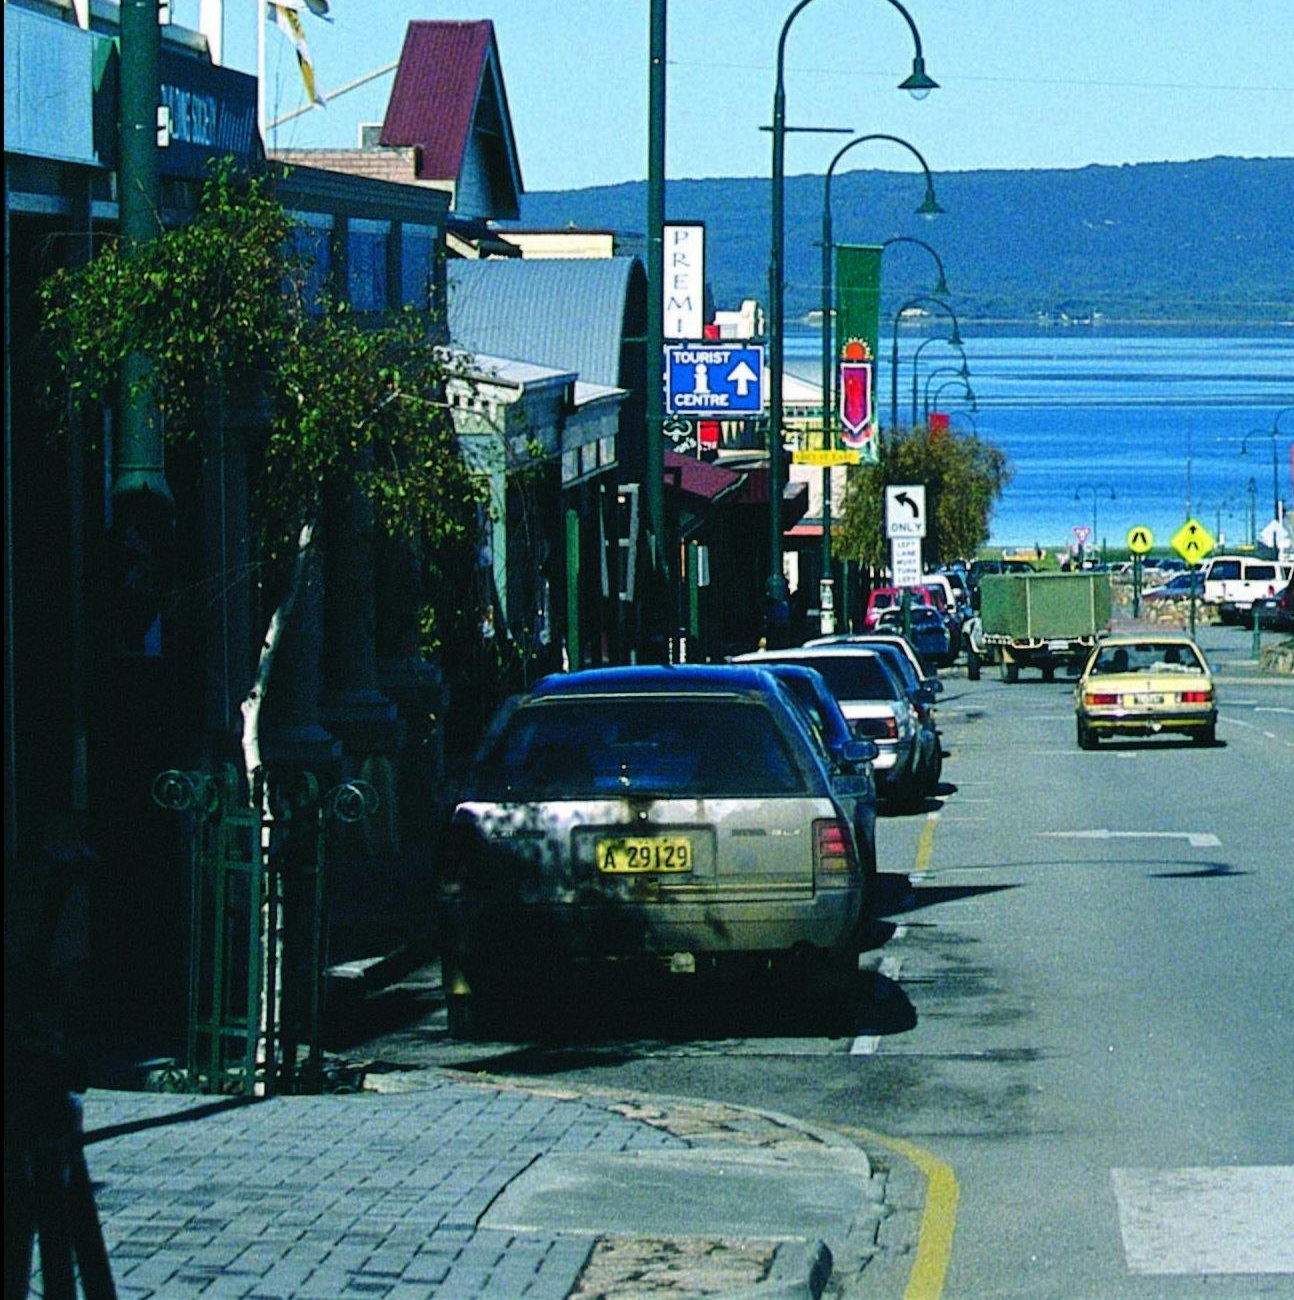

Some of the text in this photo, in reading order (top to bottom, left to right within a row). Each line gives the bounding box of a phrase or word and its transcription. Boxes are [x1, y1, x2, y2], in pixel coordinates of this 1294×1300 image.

[667, 230, 693, 333] PREMI
[672, 352, 731, 364] TOURIST
[674, 394, 730, 407] CENTRE
[891, 523, 921, 532] ONLY
[603, 845, 688, 869] A 29129
